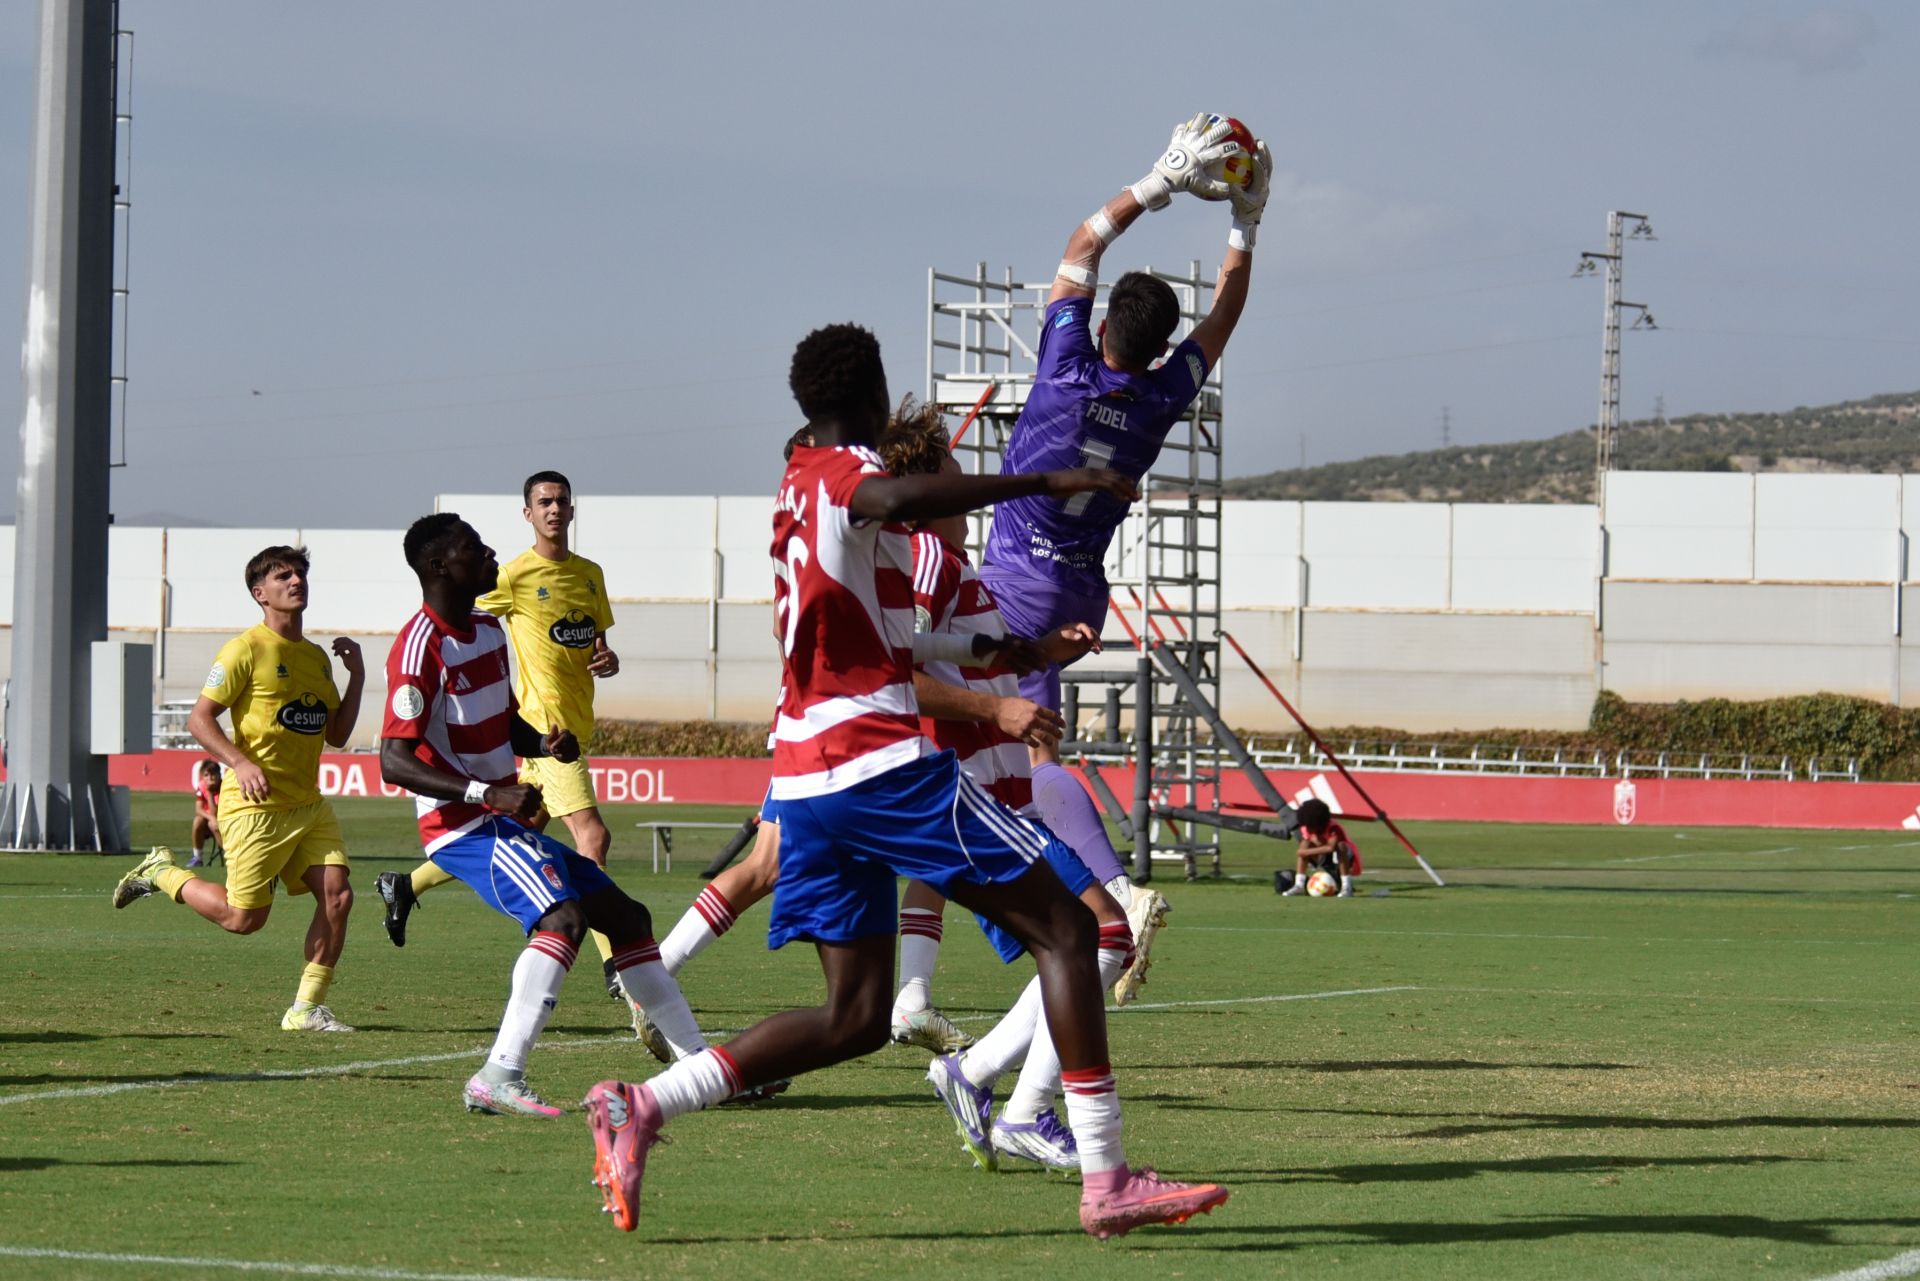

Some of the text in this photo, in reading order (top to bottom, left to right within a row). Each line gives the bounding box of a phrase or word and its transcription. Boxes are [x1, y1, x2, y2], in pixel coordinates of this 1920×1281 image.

[1086, 401, 1128, 431] FIDEL
[588, 768, 674, 802] TBOL
[509, 831, 553, 862] 12
